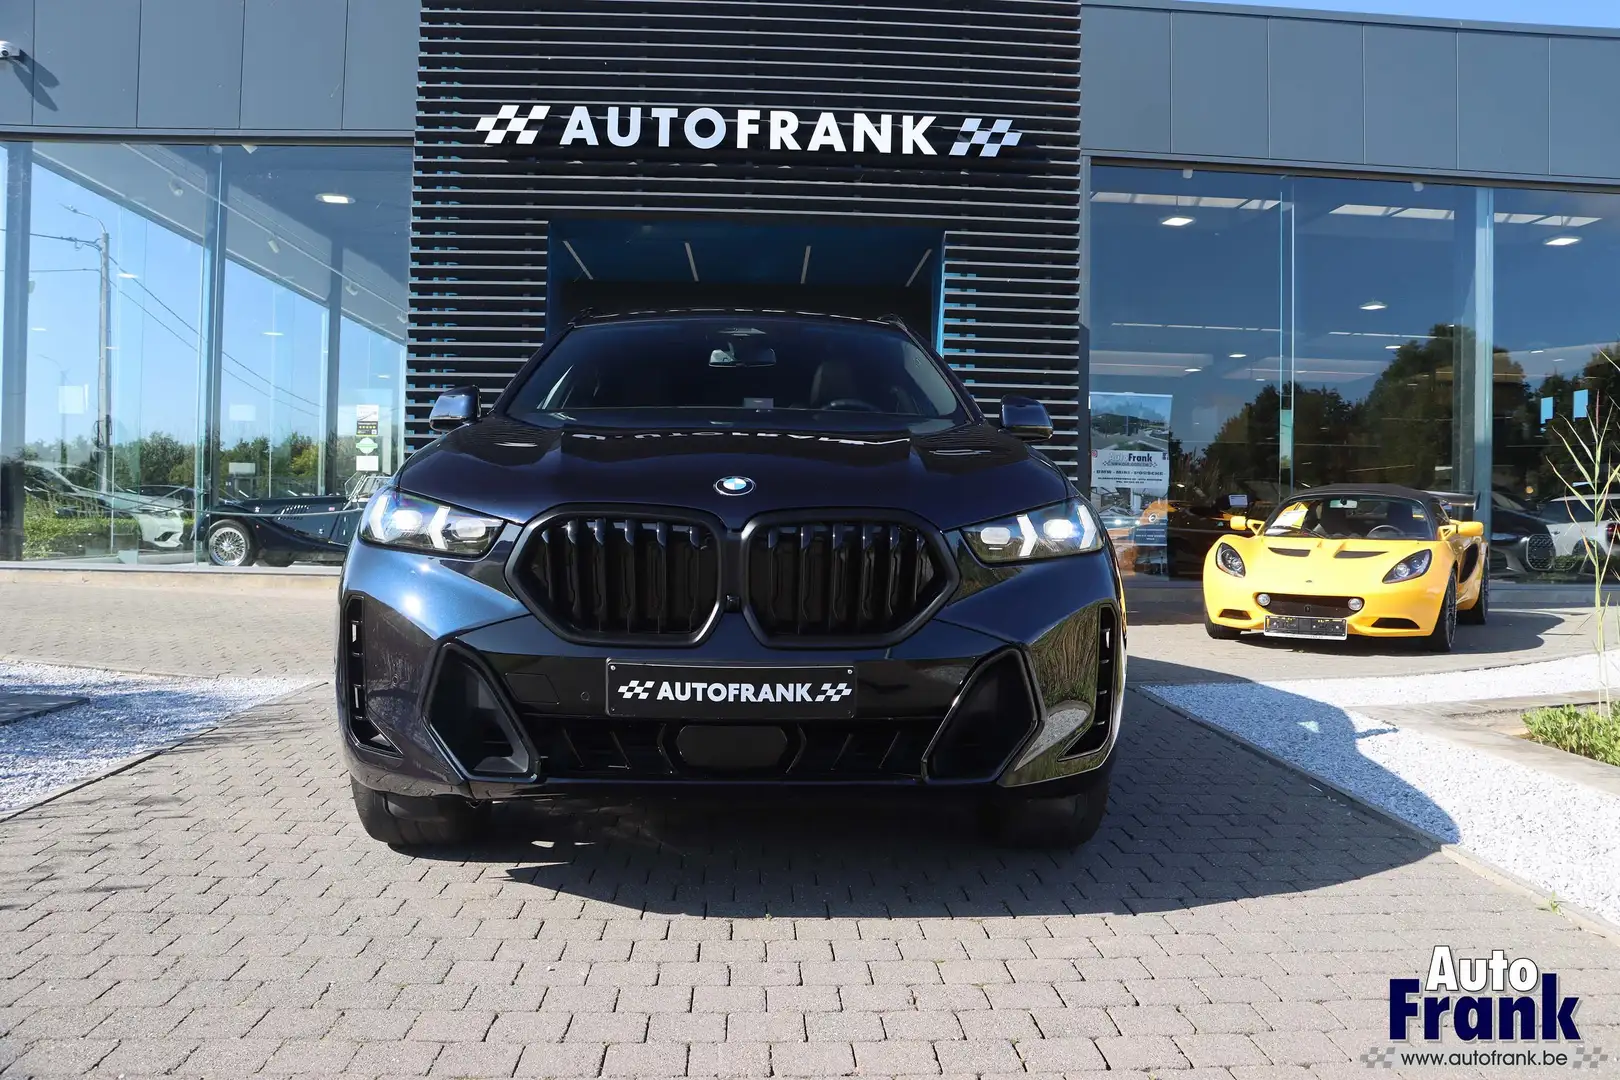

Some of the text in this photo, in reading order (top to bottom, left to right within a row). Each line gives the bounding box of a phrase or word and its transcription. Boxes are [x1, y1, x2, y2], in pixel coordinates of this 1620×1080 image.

[559, 105, 938, 156] AUTOFRANK
[1128, 453, 1153, 462] Frank
[656, 681, 813, 702] AUTOFRANK
